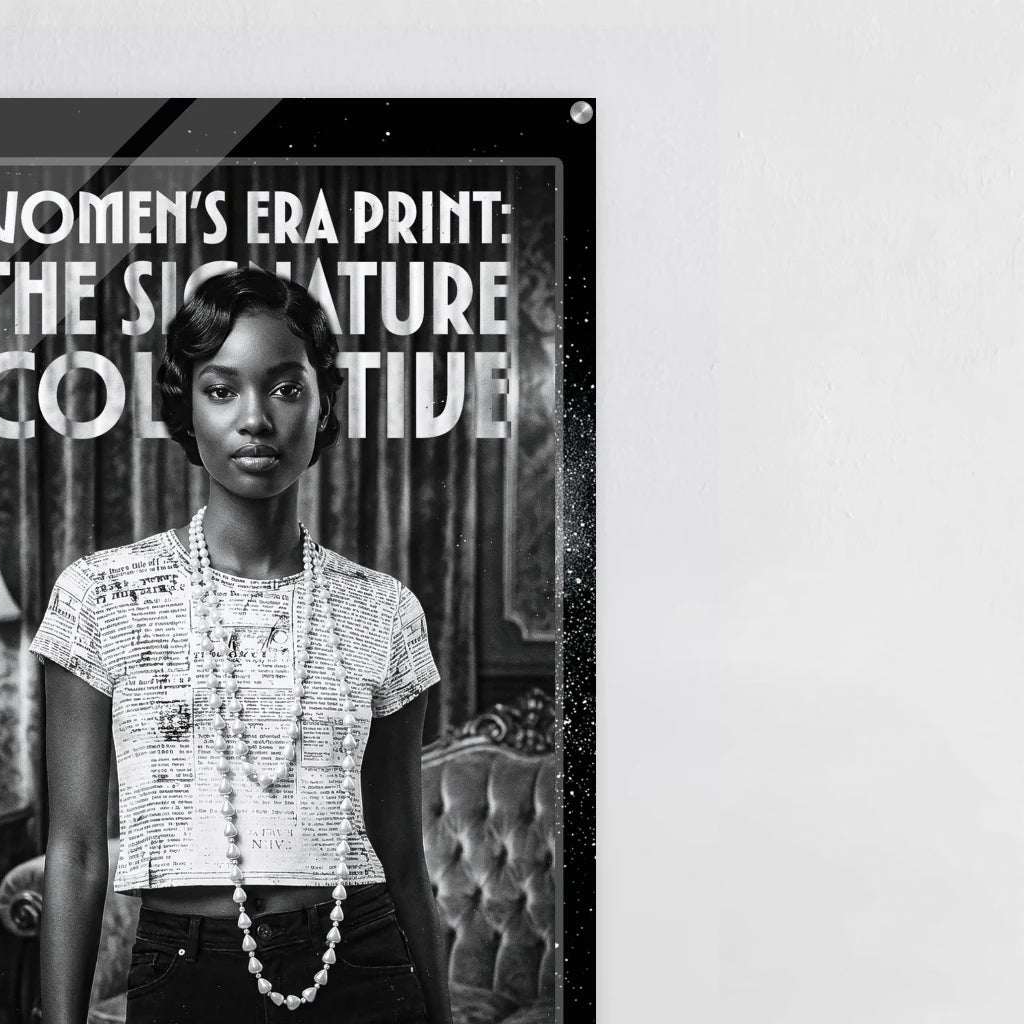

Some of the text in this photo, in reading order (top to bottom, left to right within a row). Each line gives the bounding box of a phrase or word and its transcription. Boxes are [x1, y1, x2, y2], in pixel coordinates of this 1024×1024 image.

[247, 188, 339, 244] ERA
[354, 190, 512, 244] PRINT:
[122, 257, 511, 336] SIATURE
